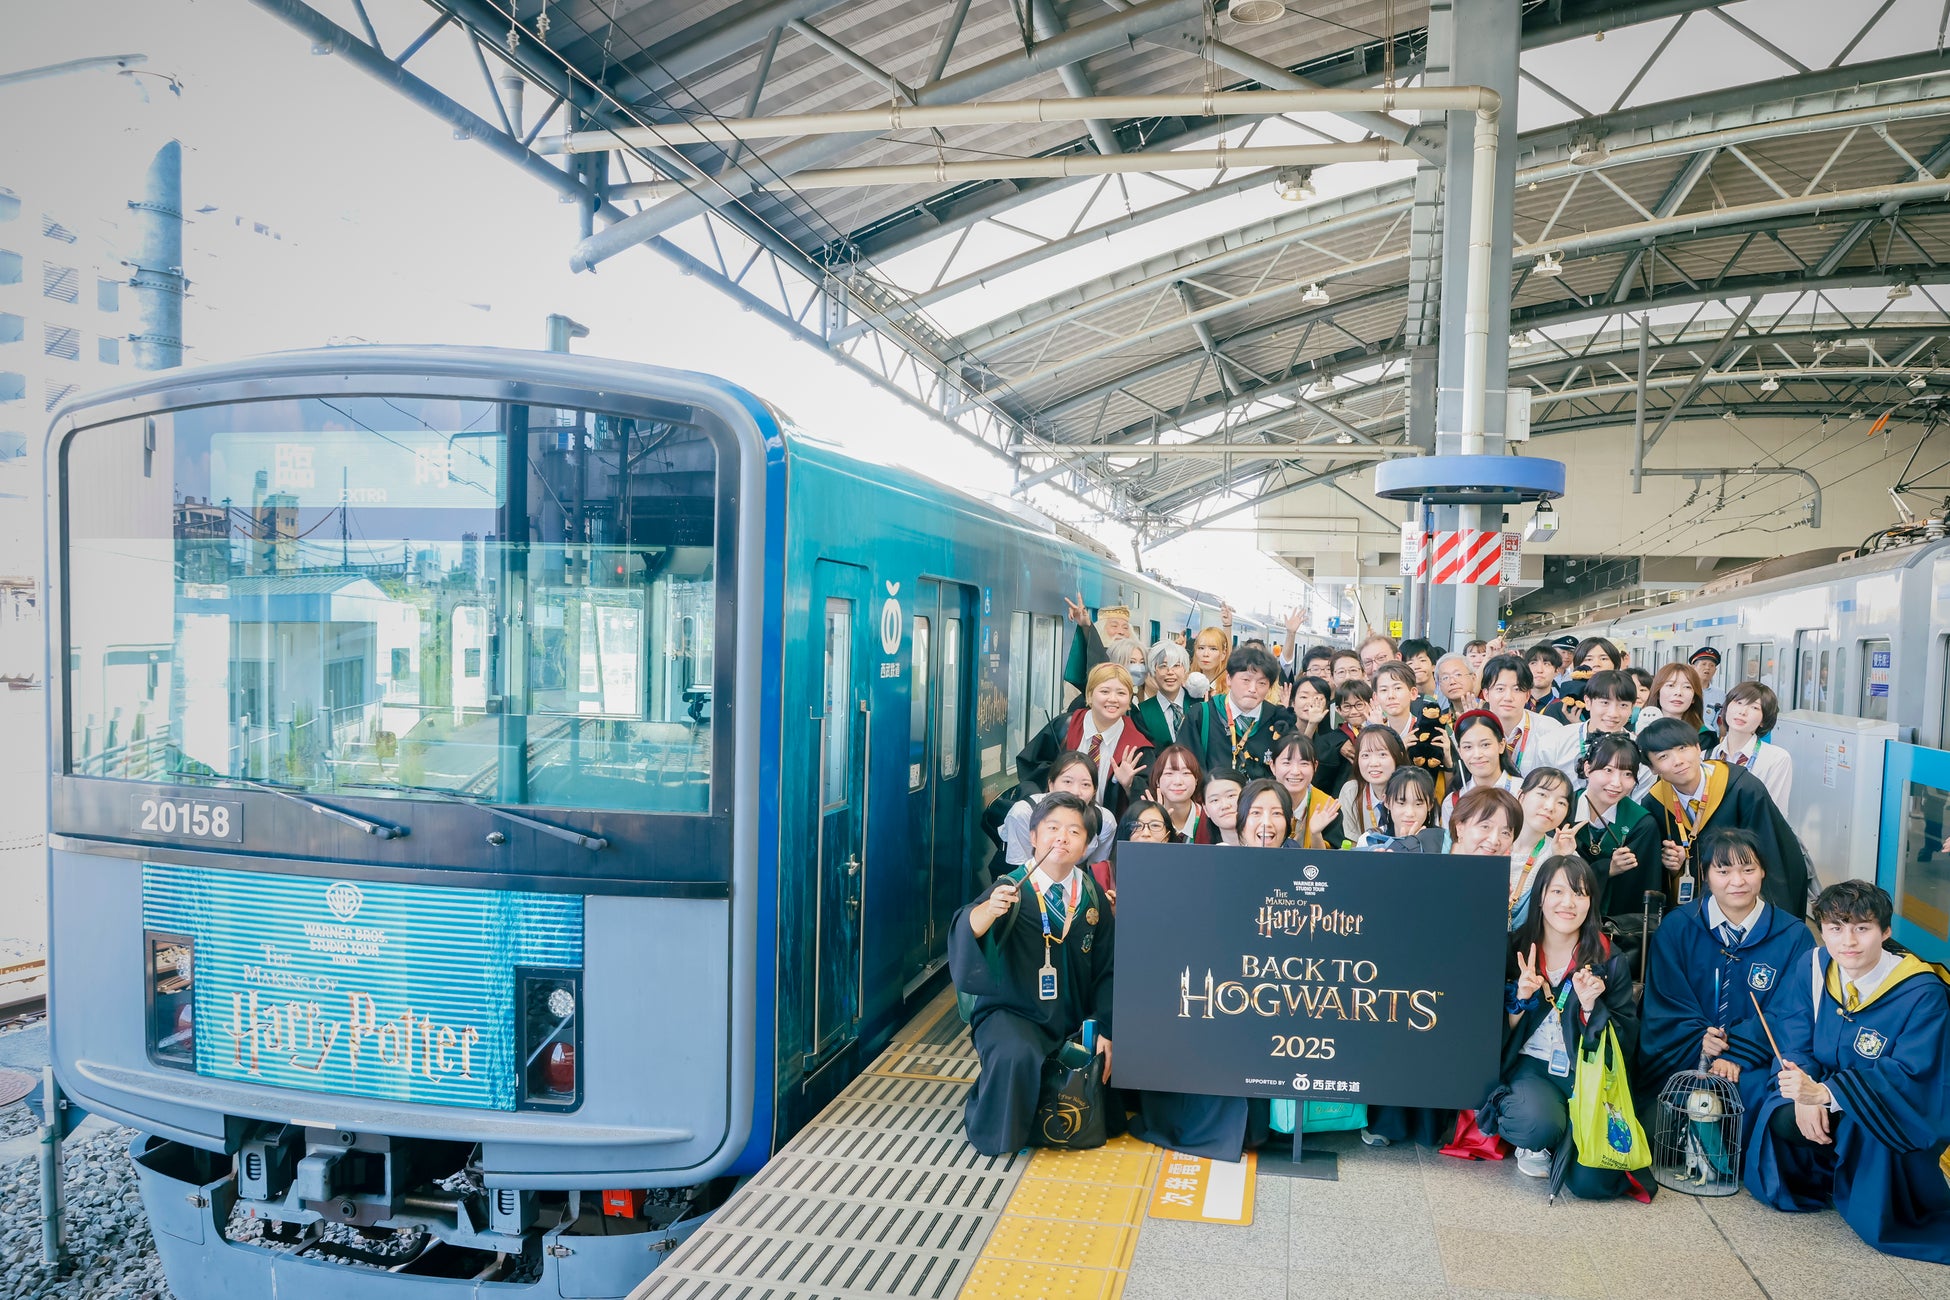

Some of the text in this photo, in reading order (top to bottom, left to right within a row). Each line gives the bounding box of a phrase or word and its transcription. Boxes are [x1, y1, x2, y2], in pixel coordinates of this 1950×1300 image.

[339, 487, 387, 502] EXTRA
[880, 662, 900, 678] 西武鉄道
[141, 800, 230, 838] 20158
[1254, 903, 1364, 942] Harry Potter
[303, 923, 388, 943] WARNER BROS.
[310, 939, 379, 957] STUDIO TOUR
[1241, 954, 1378, 984] BACK TO
[223, 989, 479, 1084] Harry Potter
[1270, 1034, 1336, 1060] 2025
[1245, 1078, 1277, 1086] SUPPORTED
[1312, 1079, 1361, 1093] 西武鉄道
